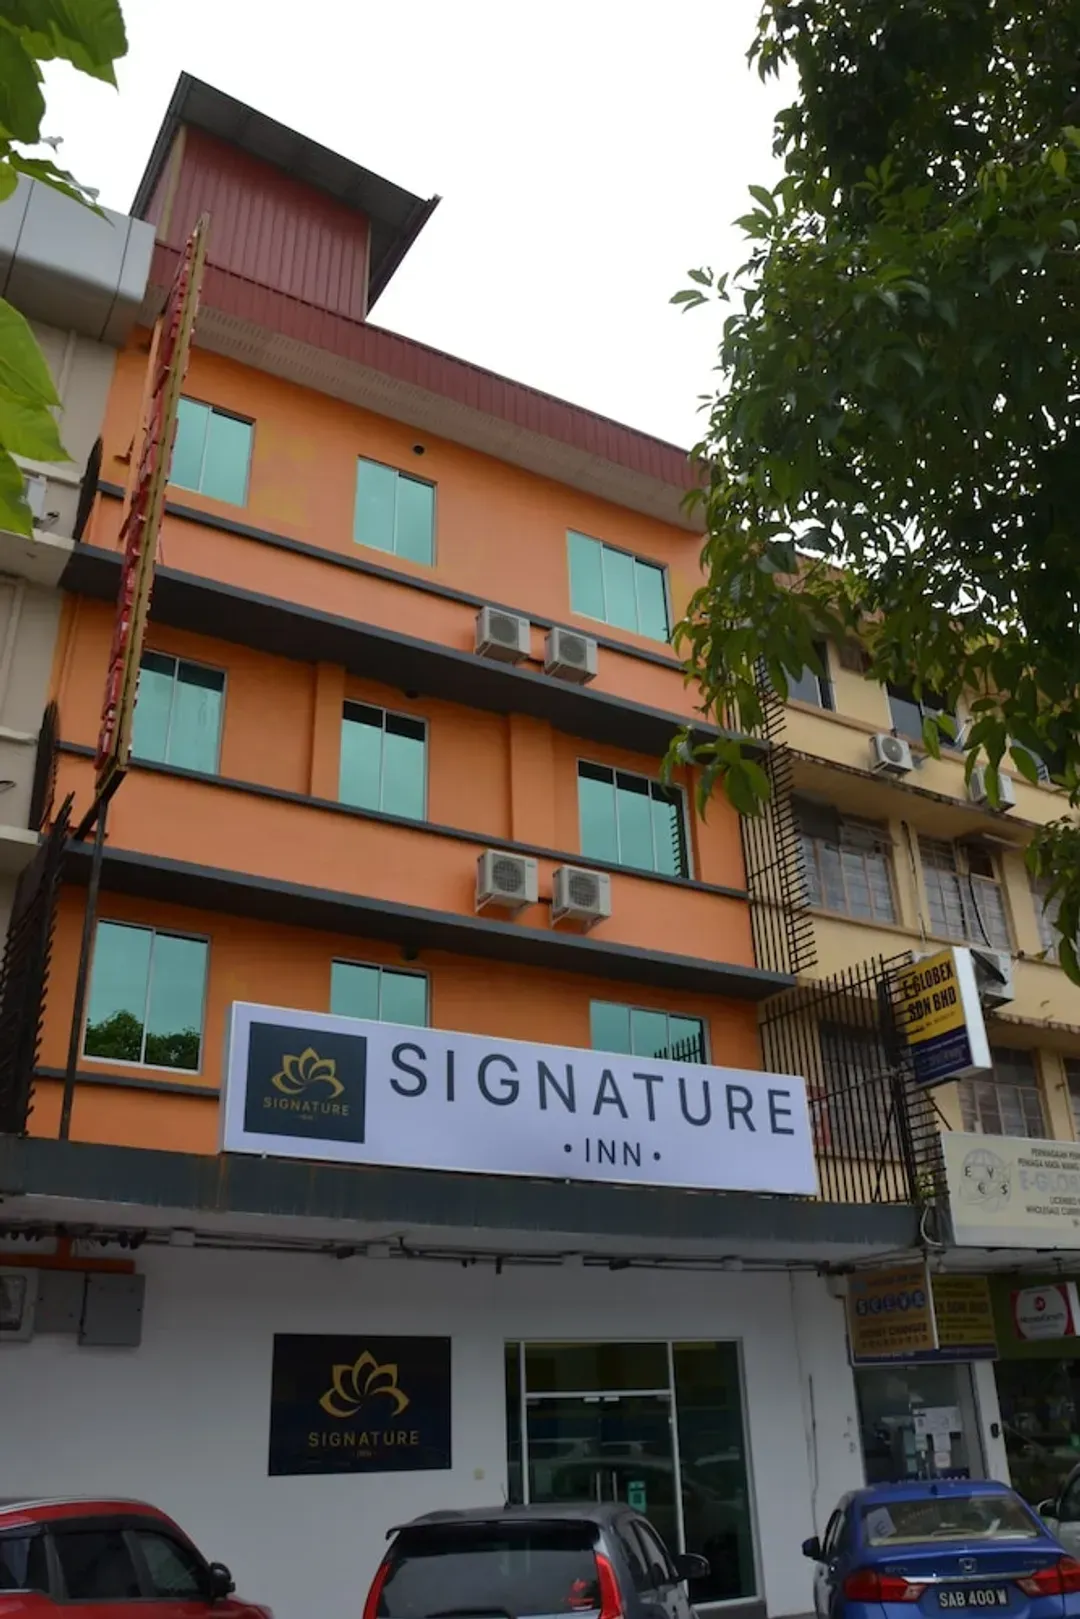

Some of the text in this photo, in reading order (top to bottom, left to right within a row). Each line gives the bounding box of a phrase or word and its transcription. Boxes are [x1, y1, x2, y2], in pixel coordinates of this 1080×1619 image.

[908, 986, 956, 1021] SDN BHD
[390, 1042, 795, 1136] SIGNATURE
[263, 1096, 349, 1117] SIGNATURE
[308, 1430, 420, 1448] SIGNATURE
[940, 1591, 966, 1607] SAB
[968, 1589, 995, 1605] 400
